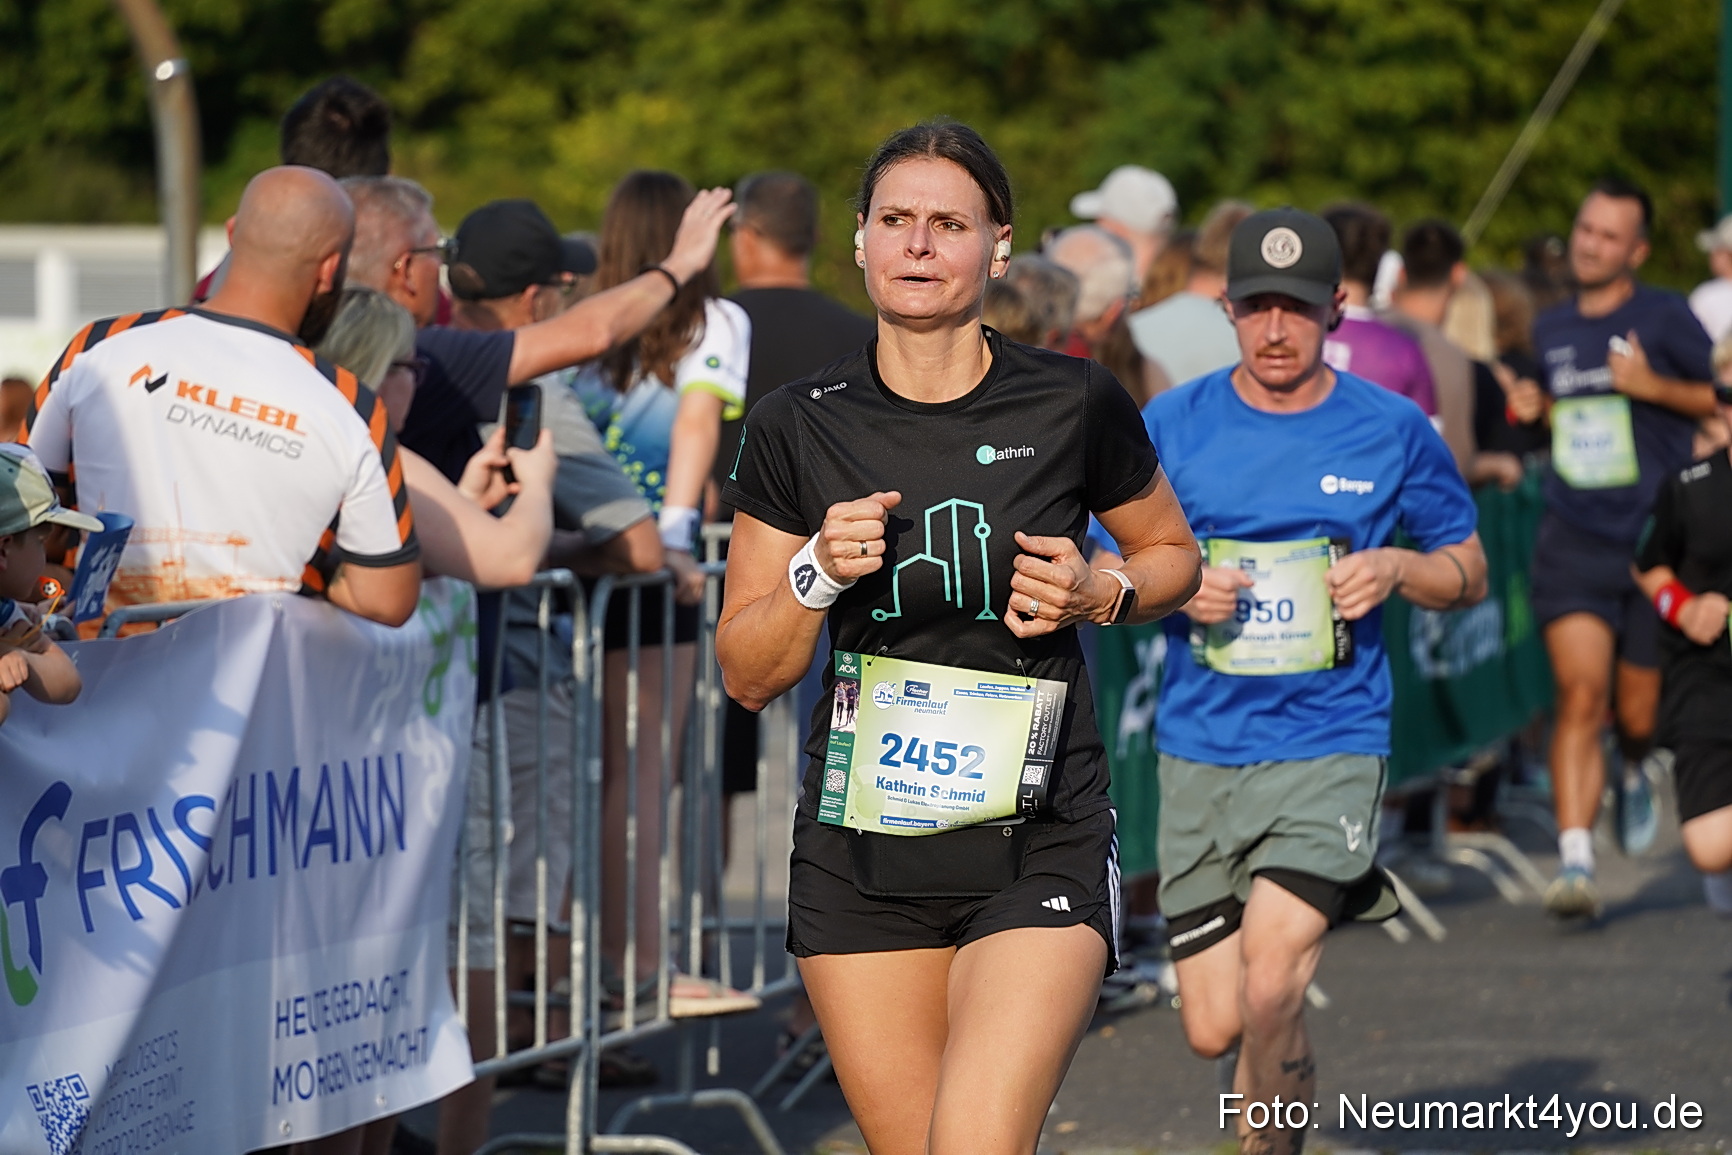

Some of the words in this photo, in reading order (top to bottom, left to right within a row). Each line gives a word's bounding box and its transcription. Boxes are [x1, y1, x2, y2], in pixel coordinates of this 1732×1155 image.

[823, 381, 848, 394] JAKO
[176, 380, 307, 436] KLEBL
[166, 404, 305, 460] DYNAMICS
[986, 444, 1035, 462] Kathrin
[838, 664, 858, 675] AOK
[896, 696, 949, 710] Firmenlauf
[914, 707, 946, 716] neumarkt
[1033, 689, 1045, 727] RABATT
[1041, 692, 1053, 725] OUTLET
[1027, 742, 1036, 756] 20
[1030, 731, 1038, 742] %
[1036, 725, 1049, 756] FACTORY
[879, 732, 987, 780] 2452
[875, 776, 927, 796] Kathrin
[929, 785, 986, 803] Schmid
[887, 795, 904, 803] Schmid
[77, 753, 407, 933] FRISCHMANN
[275, 993, 333, 1039] HEUTE
[272, 1051, 354, 1106] MORGEN
